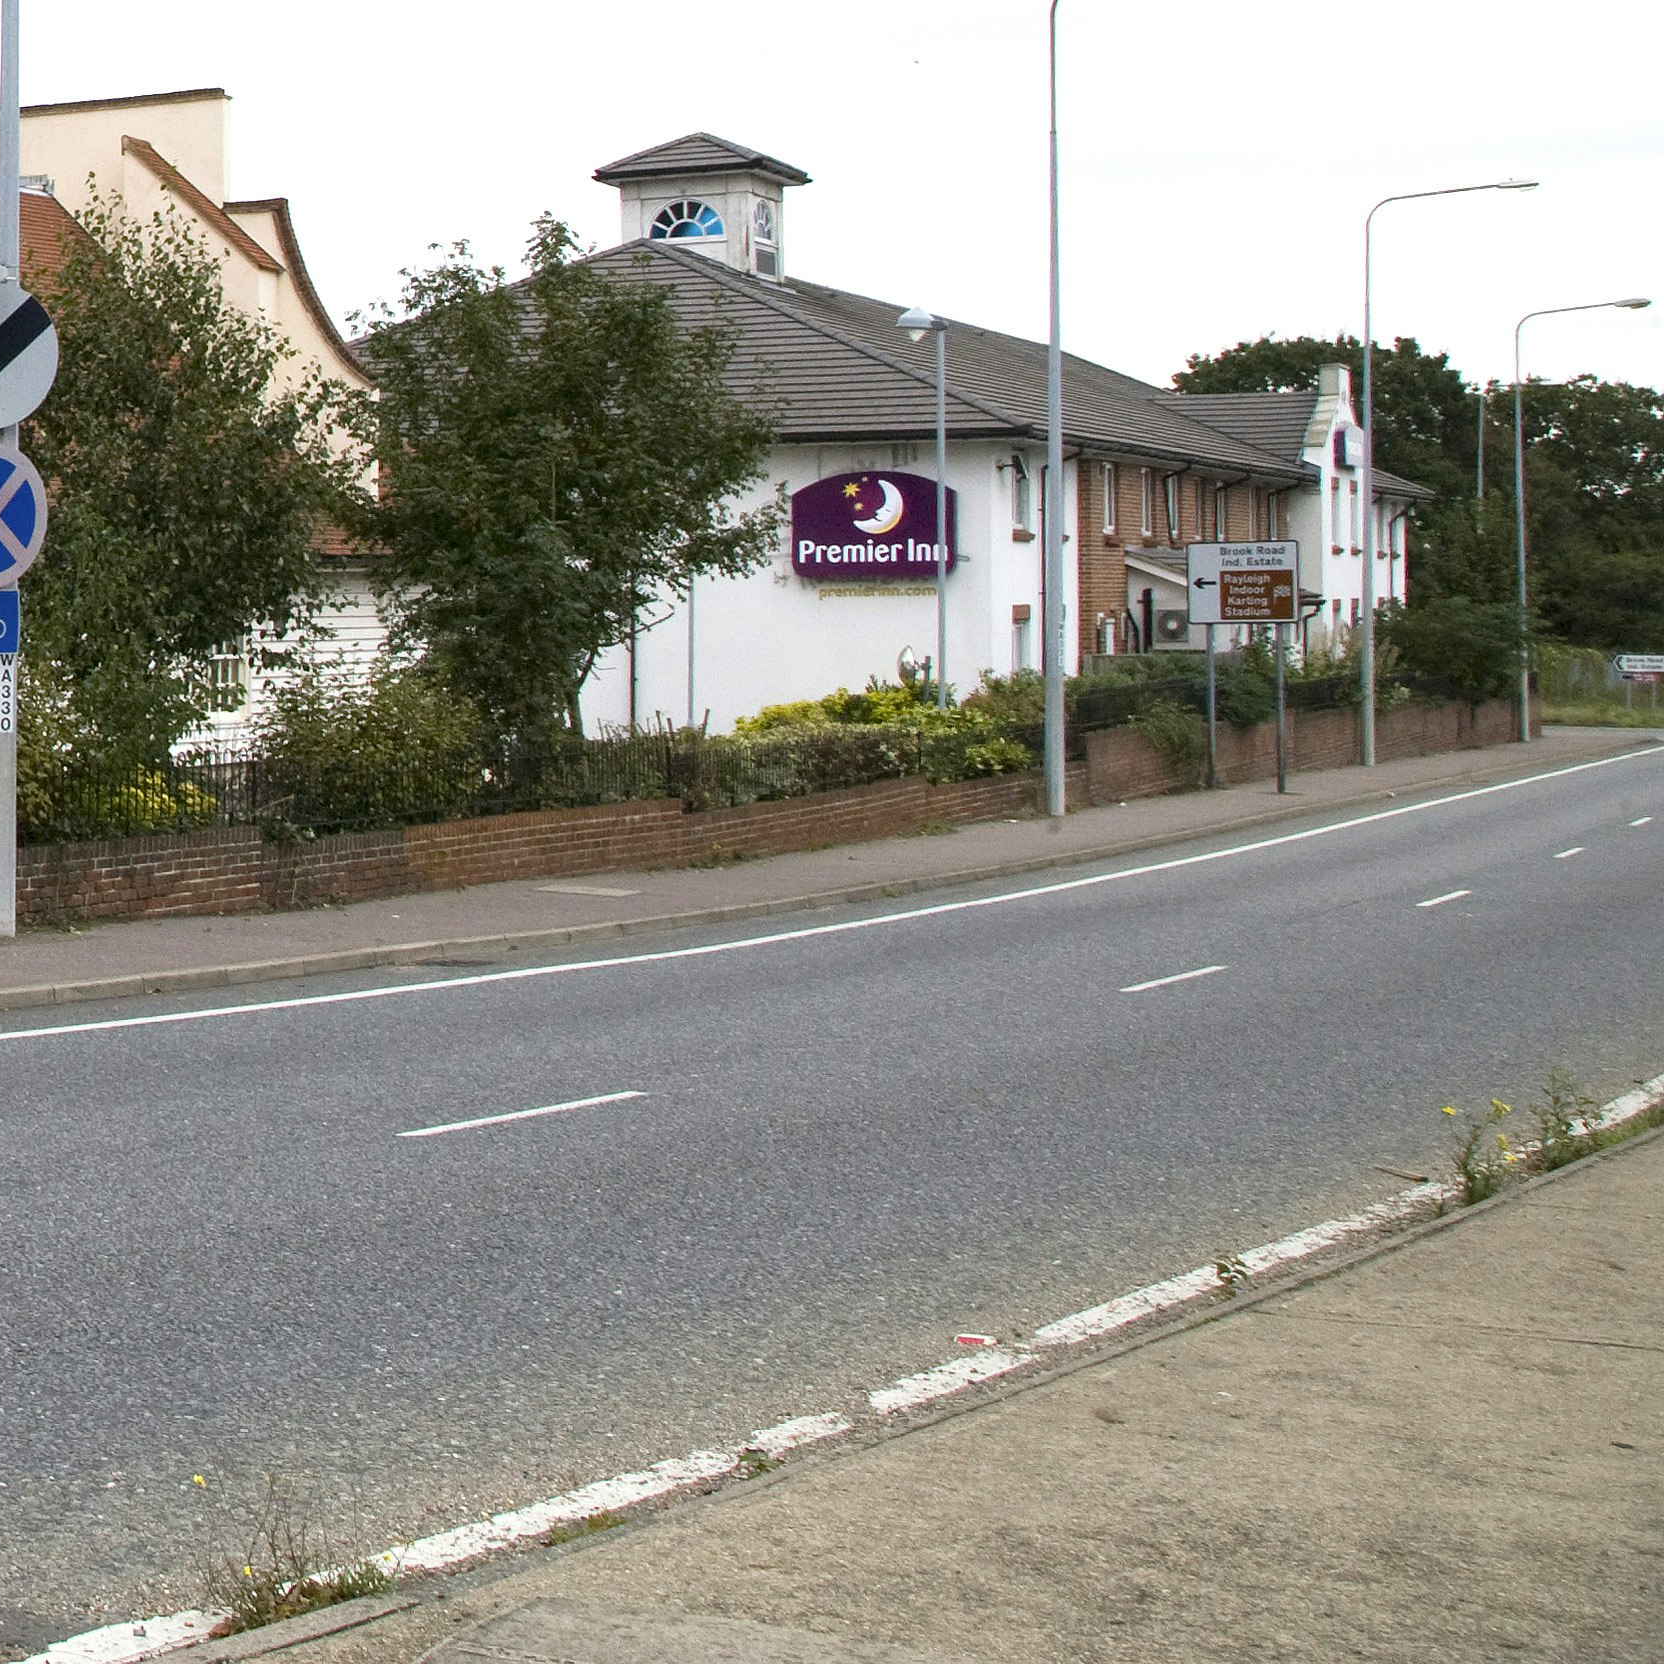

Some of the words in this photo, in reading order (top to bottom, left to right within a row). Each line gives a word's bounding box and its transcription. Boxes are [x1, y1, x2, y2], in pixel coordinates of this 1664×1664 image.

[798, 539, 903, 563] Premier
[907, 538, 948, 562] Inn
[1219, 546, 1253, 556] Brook
[1256, 545, 1286, 555] Road
[1247, 557, 1283, 566] Estate
[1224, 574, 1271, 585] Rayleigh
[1229, 585, 1266, 595] Indoor
[1227, 596, 1268, 606] Karting
[1224, 606, 1271, 617] Stadium
